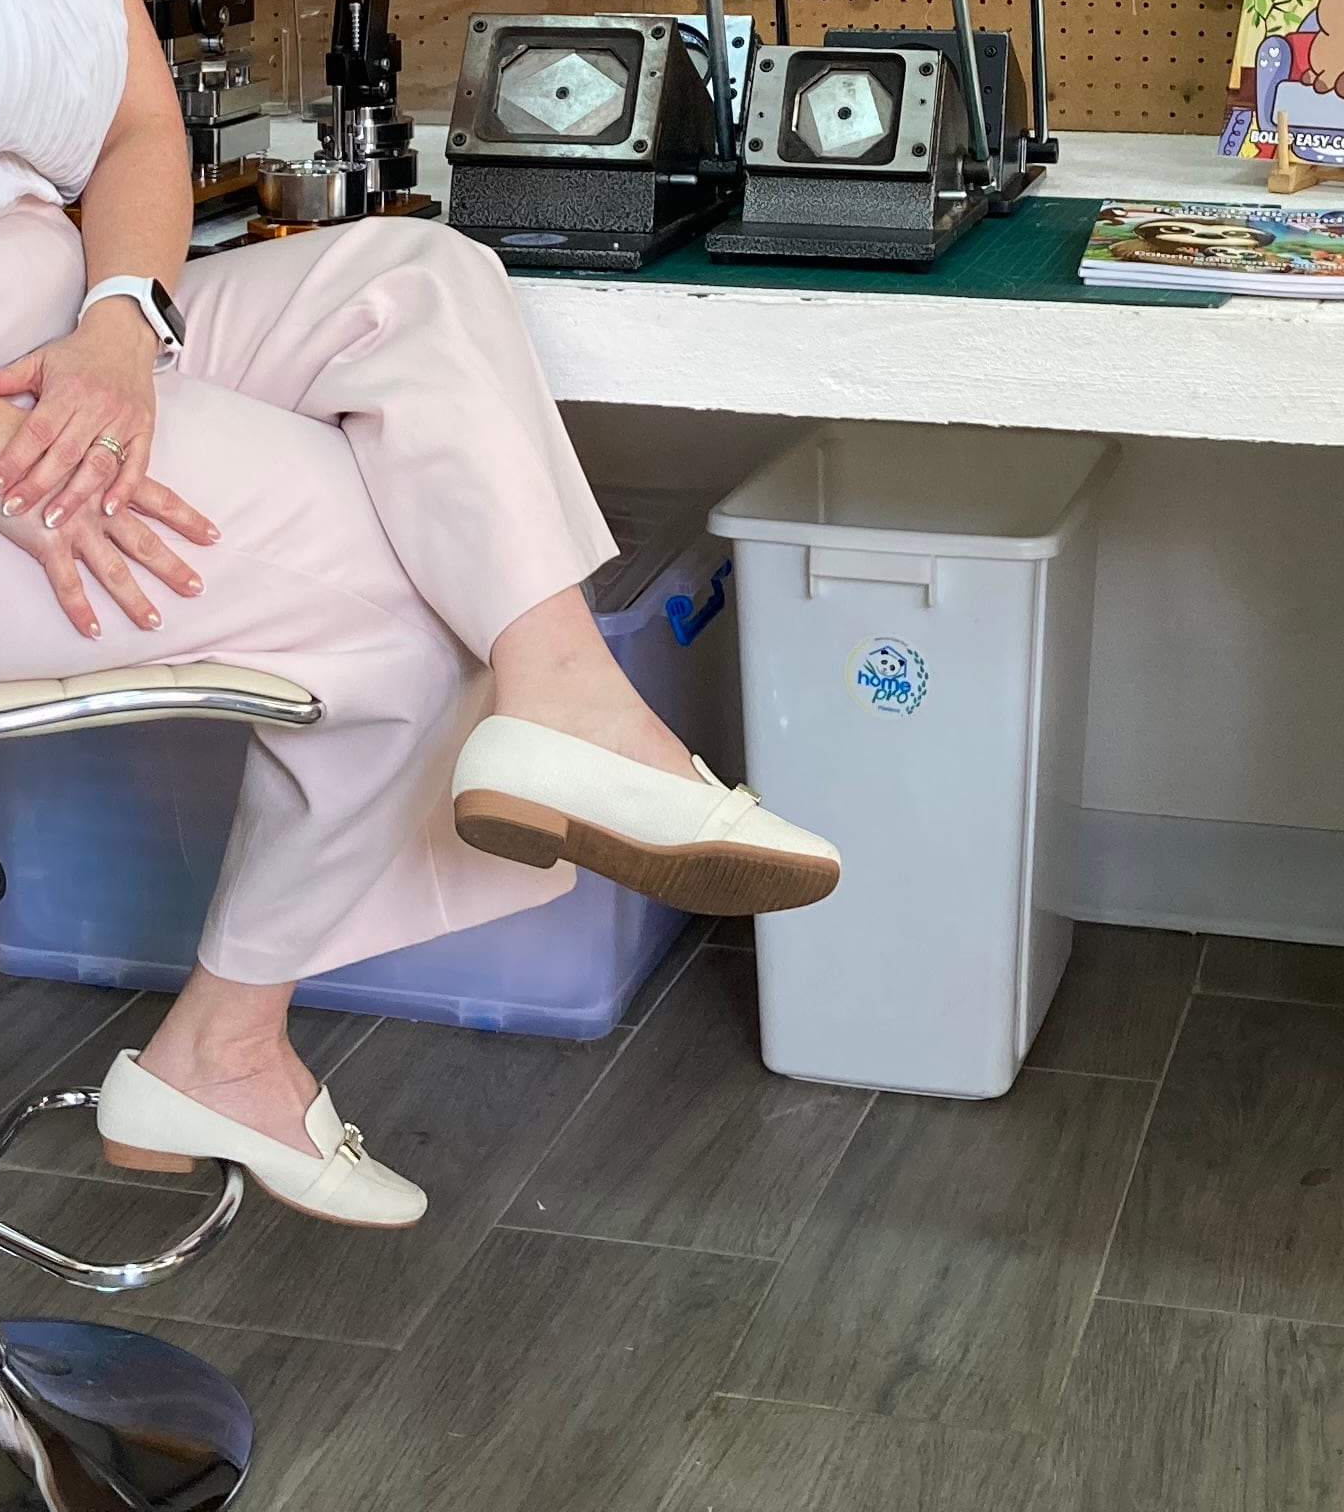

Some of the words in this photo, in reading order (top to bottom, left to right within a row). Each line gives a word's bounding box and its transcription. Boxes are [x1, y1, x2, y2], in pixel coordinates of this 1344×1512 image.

[1250, 131, 1278, 144] BOL
[858, 670, 912, 693] home
[872, 688, 908, 704] pro
